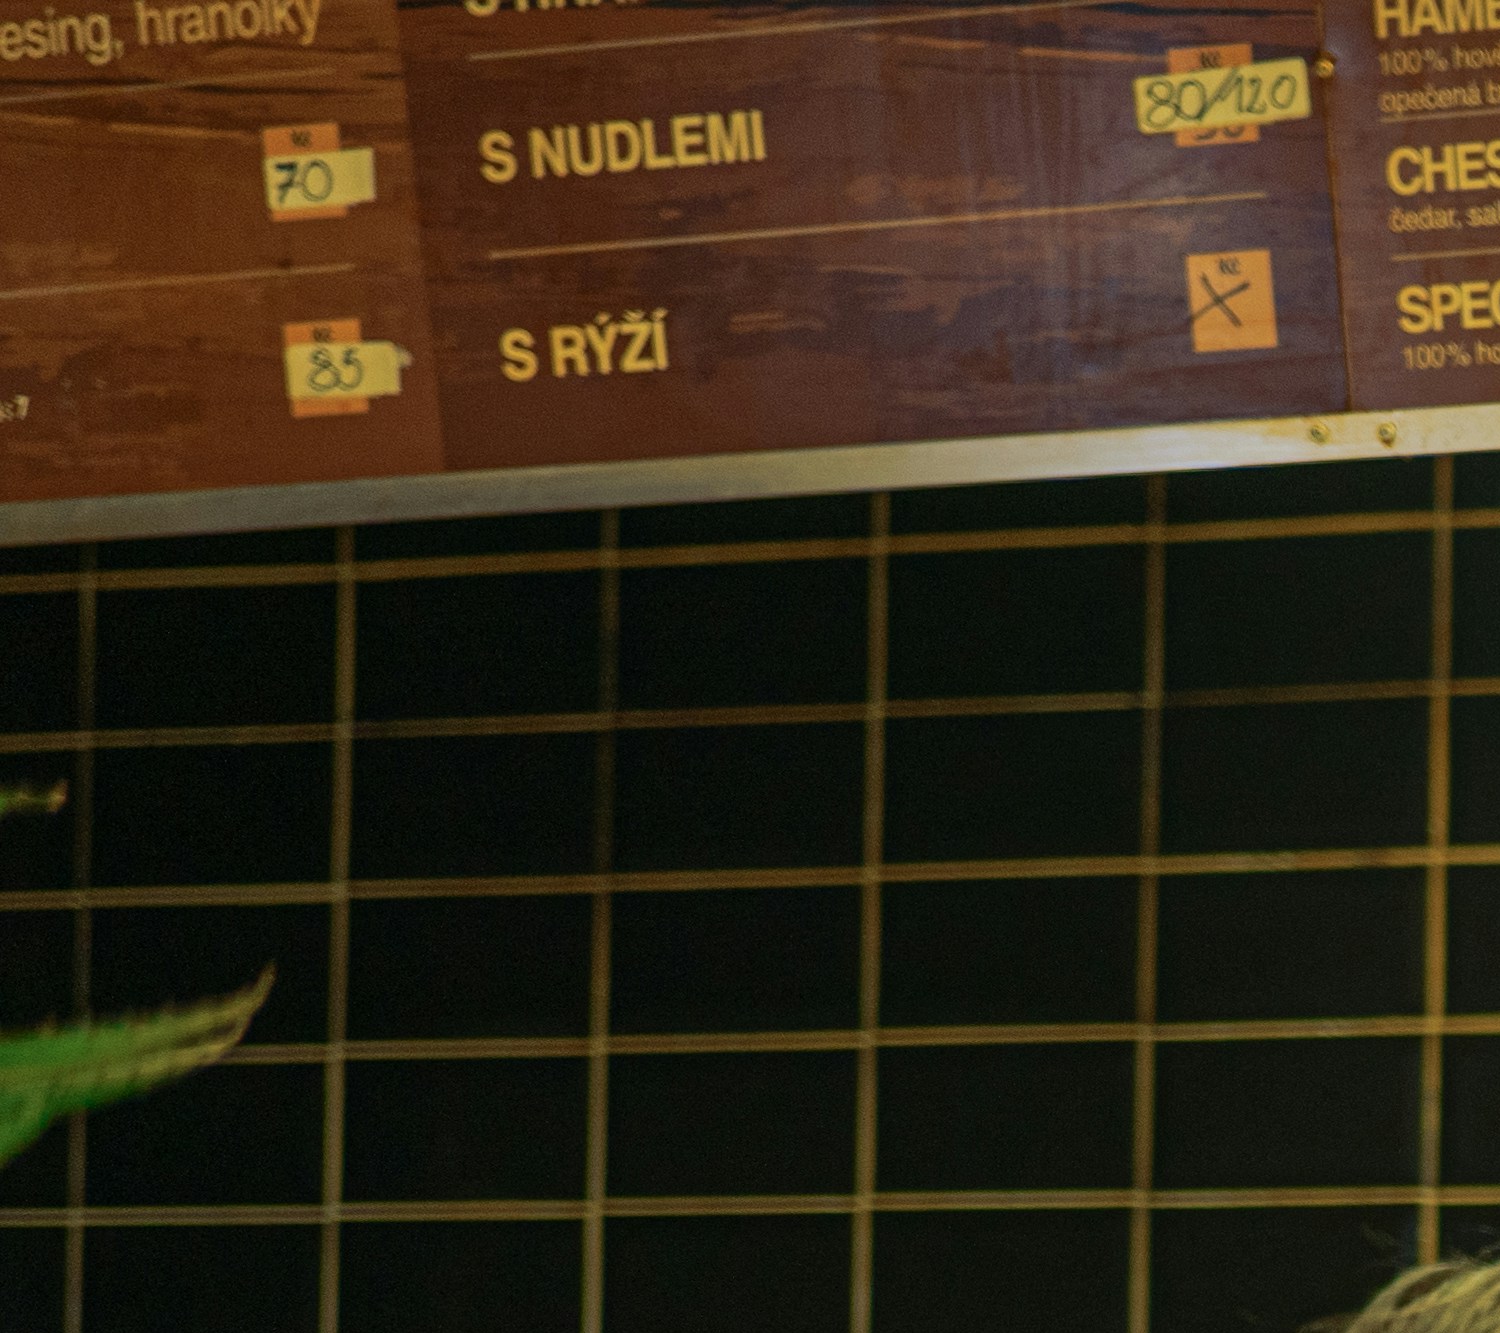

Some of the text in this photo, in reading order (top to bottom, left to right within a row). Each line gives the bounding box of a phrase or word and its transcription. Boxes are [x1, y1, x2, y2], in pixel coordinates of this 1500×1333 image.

[1146, 66, 1298, 130] 80/120
[479, 109, 766, 183] S NUDLEMI
[273, 159, 334, 203] 70
[499, 307, 669, 381] S RÝŽÍ
[1403, 342, 1471, 371] 100%
